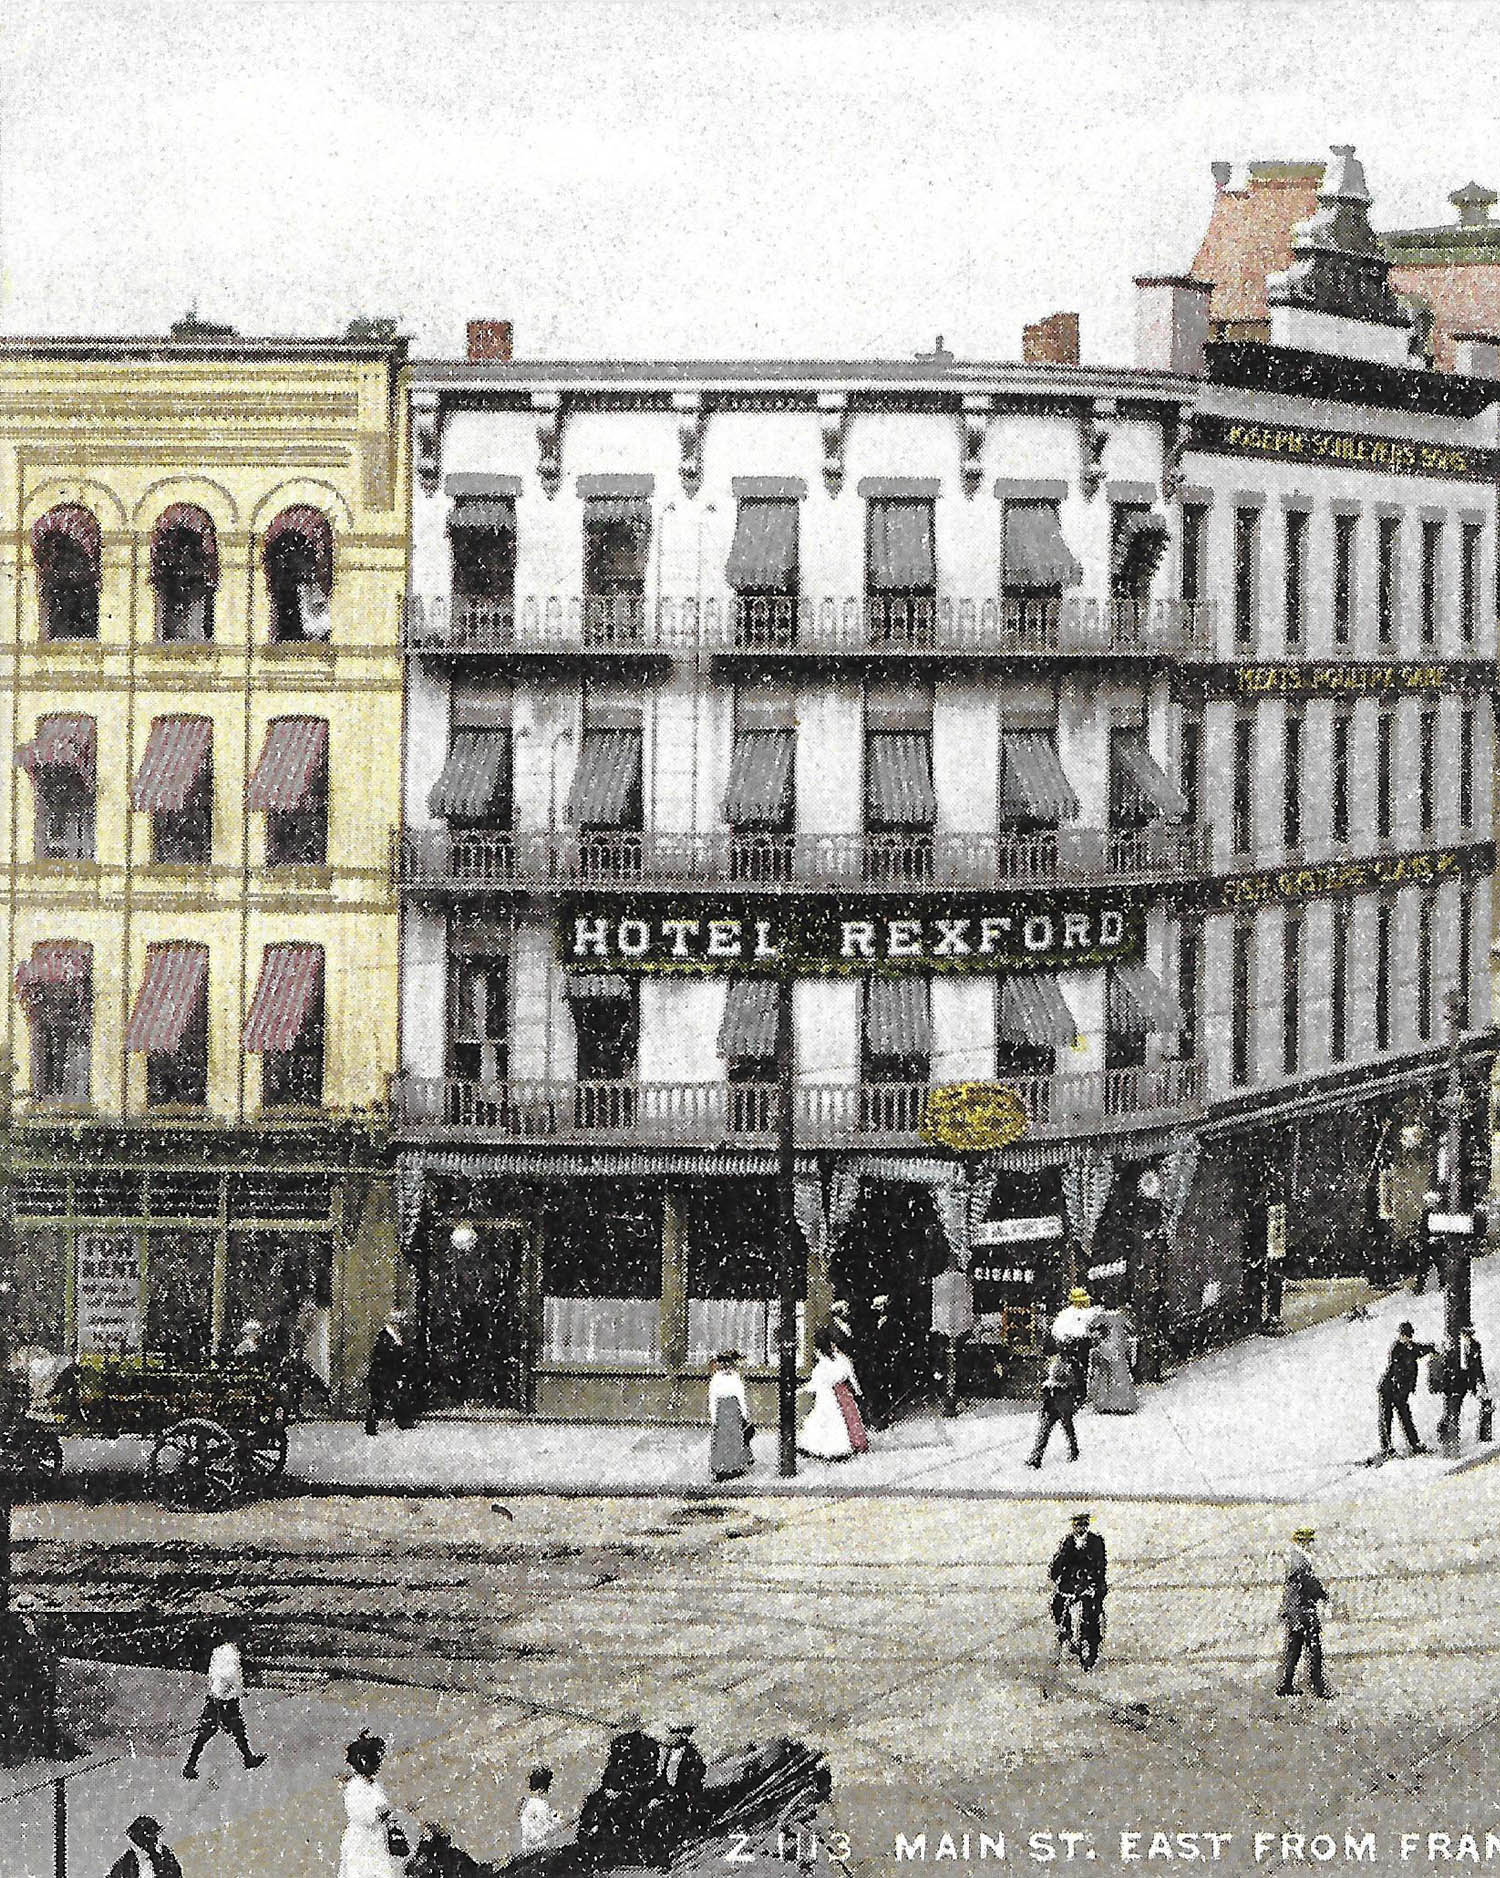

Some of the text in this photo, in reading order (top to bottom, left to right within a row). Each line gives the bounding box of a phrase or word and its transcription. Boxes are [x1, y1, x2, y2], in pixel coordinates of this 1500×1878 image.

[572, 911, 1124, 957] HOTEL REXFORD
[84, 1236, 133, 1258] FOR
[81, 1259, 140, 1279] RENT
